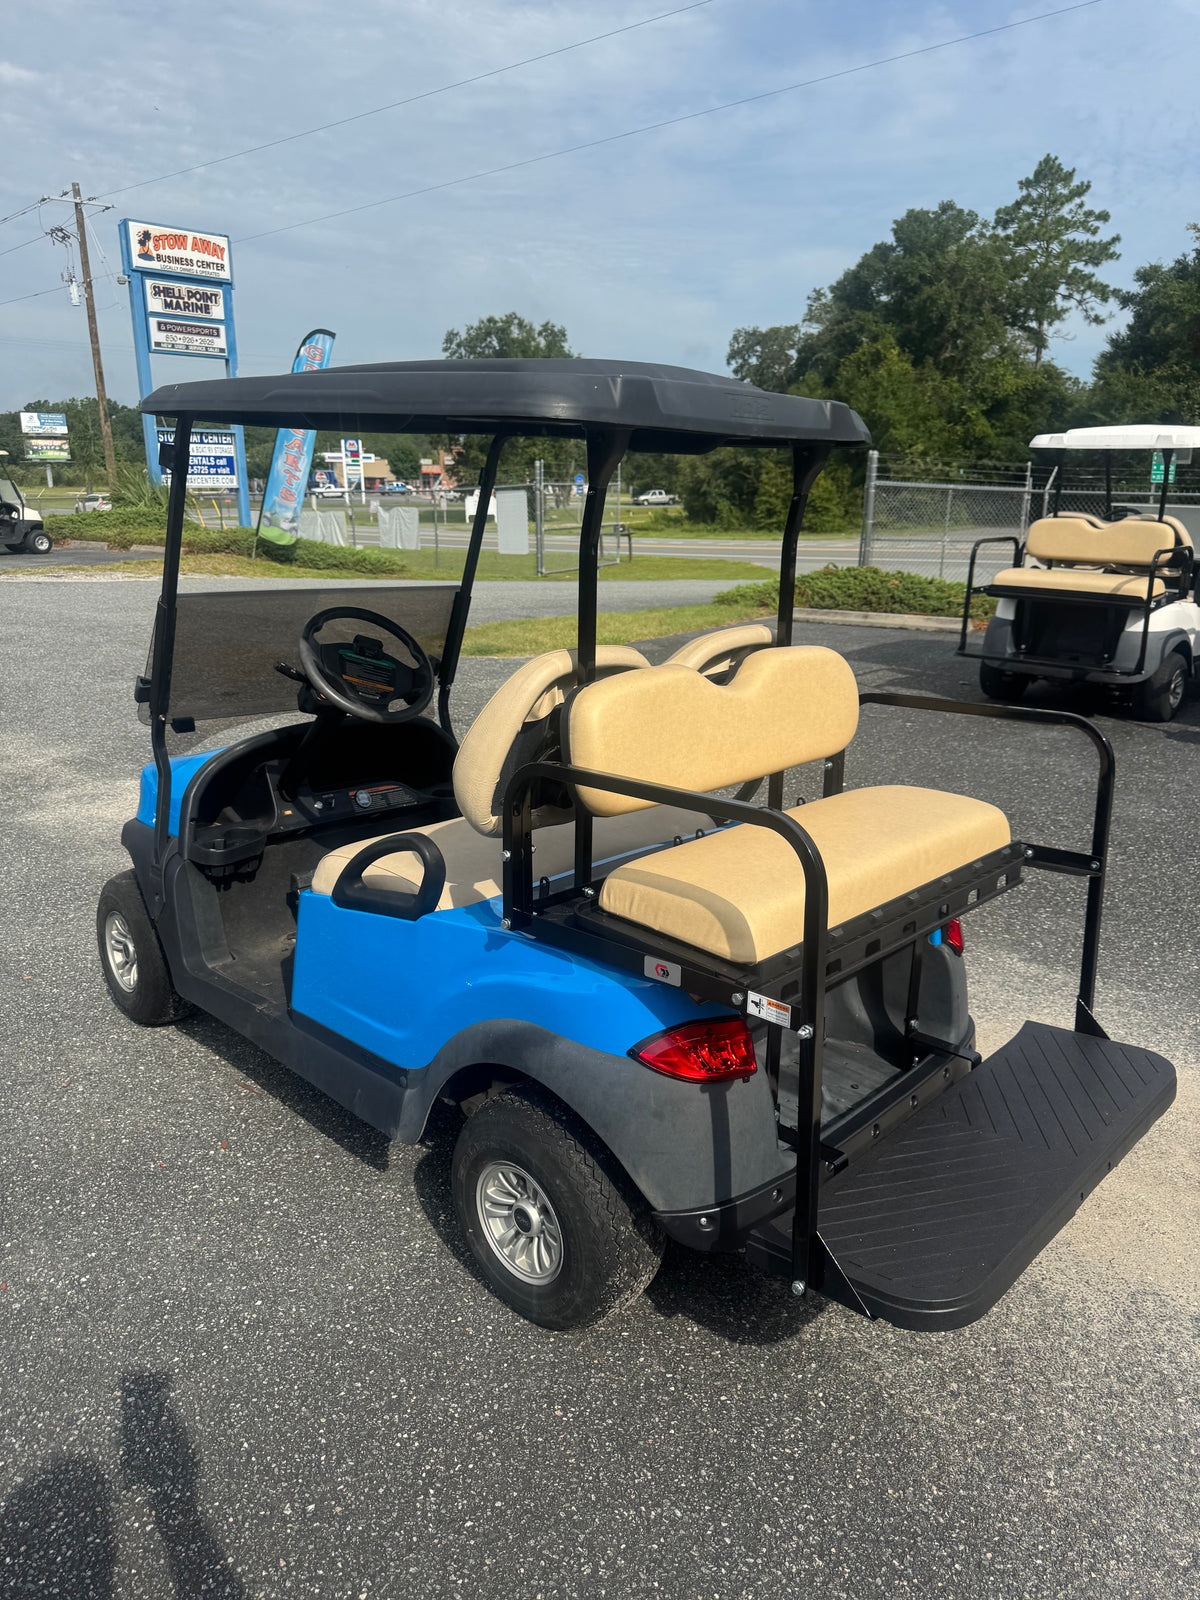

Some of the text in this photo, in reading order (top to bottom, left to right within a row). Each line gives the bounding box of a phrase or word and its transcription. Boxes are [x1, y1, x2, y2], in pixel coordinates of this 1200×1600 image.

[153, 234, 225, 261] STOW AWAY
[156, 254, 225, 272] BUSINESS CENTER
[153, 285, 219, 304] SHELL POINT
[164, 299, 211, 314] MARINE
[167, 325, 218, 336] POWERSPORTS
[202, 433, 232, 444] CENTER
[189, 456, 228, 466] ENTALS call
[217, 467, 231, 475] visit
